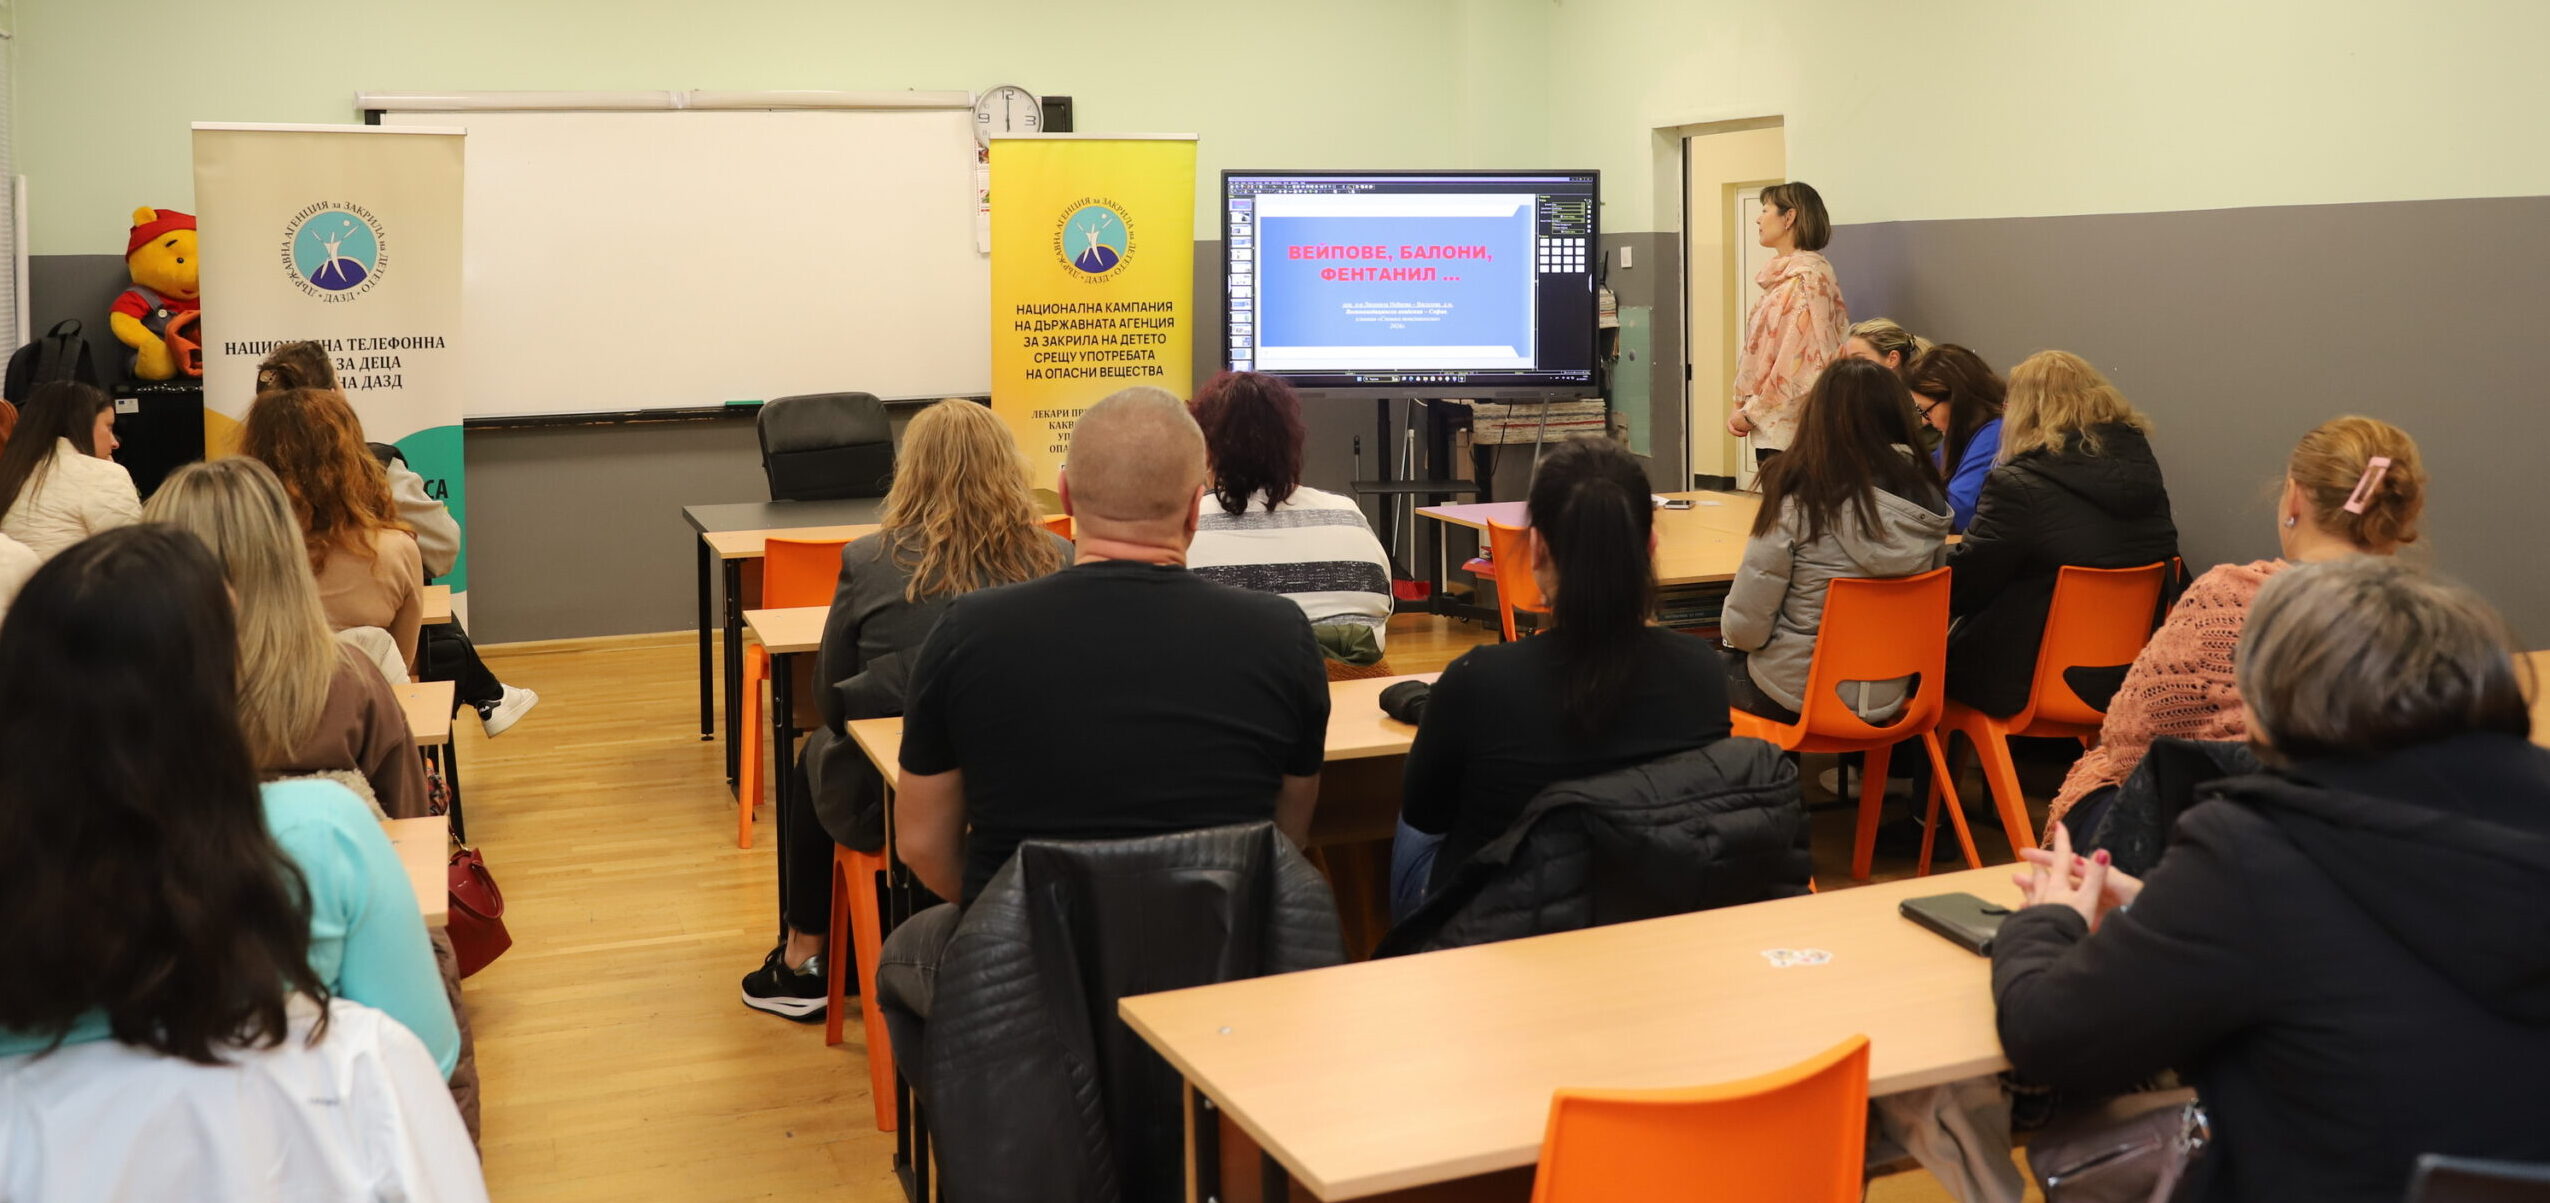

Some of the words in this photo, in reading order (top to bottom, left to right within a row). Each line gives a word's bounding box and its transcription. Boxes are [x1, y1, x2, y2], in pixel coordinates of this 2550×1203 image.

[1002, 89, 1014, 100] 12
[285, 200, 329, 239] АГЕНЦИЯ
[344, 201, 385, 239] ЗАКРИЛА
[1288, 242, 1393, 262] ВЕЙПОВЕ,
[1400, 245, 1493, 262] БАЛОНИ,
[281, 241, 318, 297] ДЪРЖАВНА
[361, 252, 388, 293] ДЕТЕТО
[1320, 267, 1436, 281] ФЕНТАНИЛ
[323, 292, 356, 303] ДАЗД
[1016, 303, 1103, 316] НАЦИОНАЛНА
[1105, 301, 1173, 313] КАМПАНИЯ
[1015, 321, 1031, 331] НА
[1034, 319, 1116, 332] ДЪРЖАВНАТА
[1119, 317, 1175, 329] АГЕНЦИЯ
[224, 338, 344, 356] НАЦИОНА
[347, 336, 446, 351] ТЕЛЕФОННА
[1023, 337, 1039, 347] ЗА
[1042, 335, 1099, 347] ЗАКРИЛА
[1101, 334, 1117, 345] НА
[1120, 333, 1167, 346] ДЕТЕТО
[336, 357, 355, 370] ЗА
[359, 356, 402, 371] ДЕЦА
[1034, 351, 1077, 364] СРЕЩУ
[1080, 349, 1155, 362] УПОТРЕБАТА
[1026, 369, 1042, 379] НА
[1045, 367, 1097, 379] ОПАСНИ
[1100, 365, 1164, 378] ВЕЩЕСТВА
[362, 374, 403, 390] ДАЗД
[1031, 409, 1069, 419] ЛЕКАРИ
